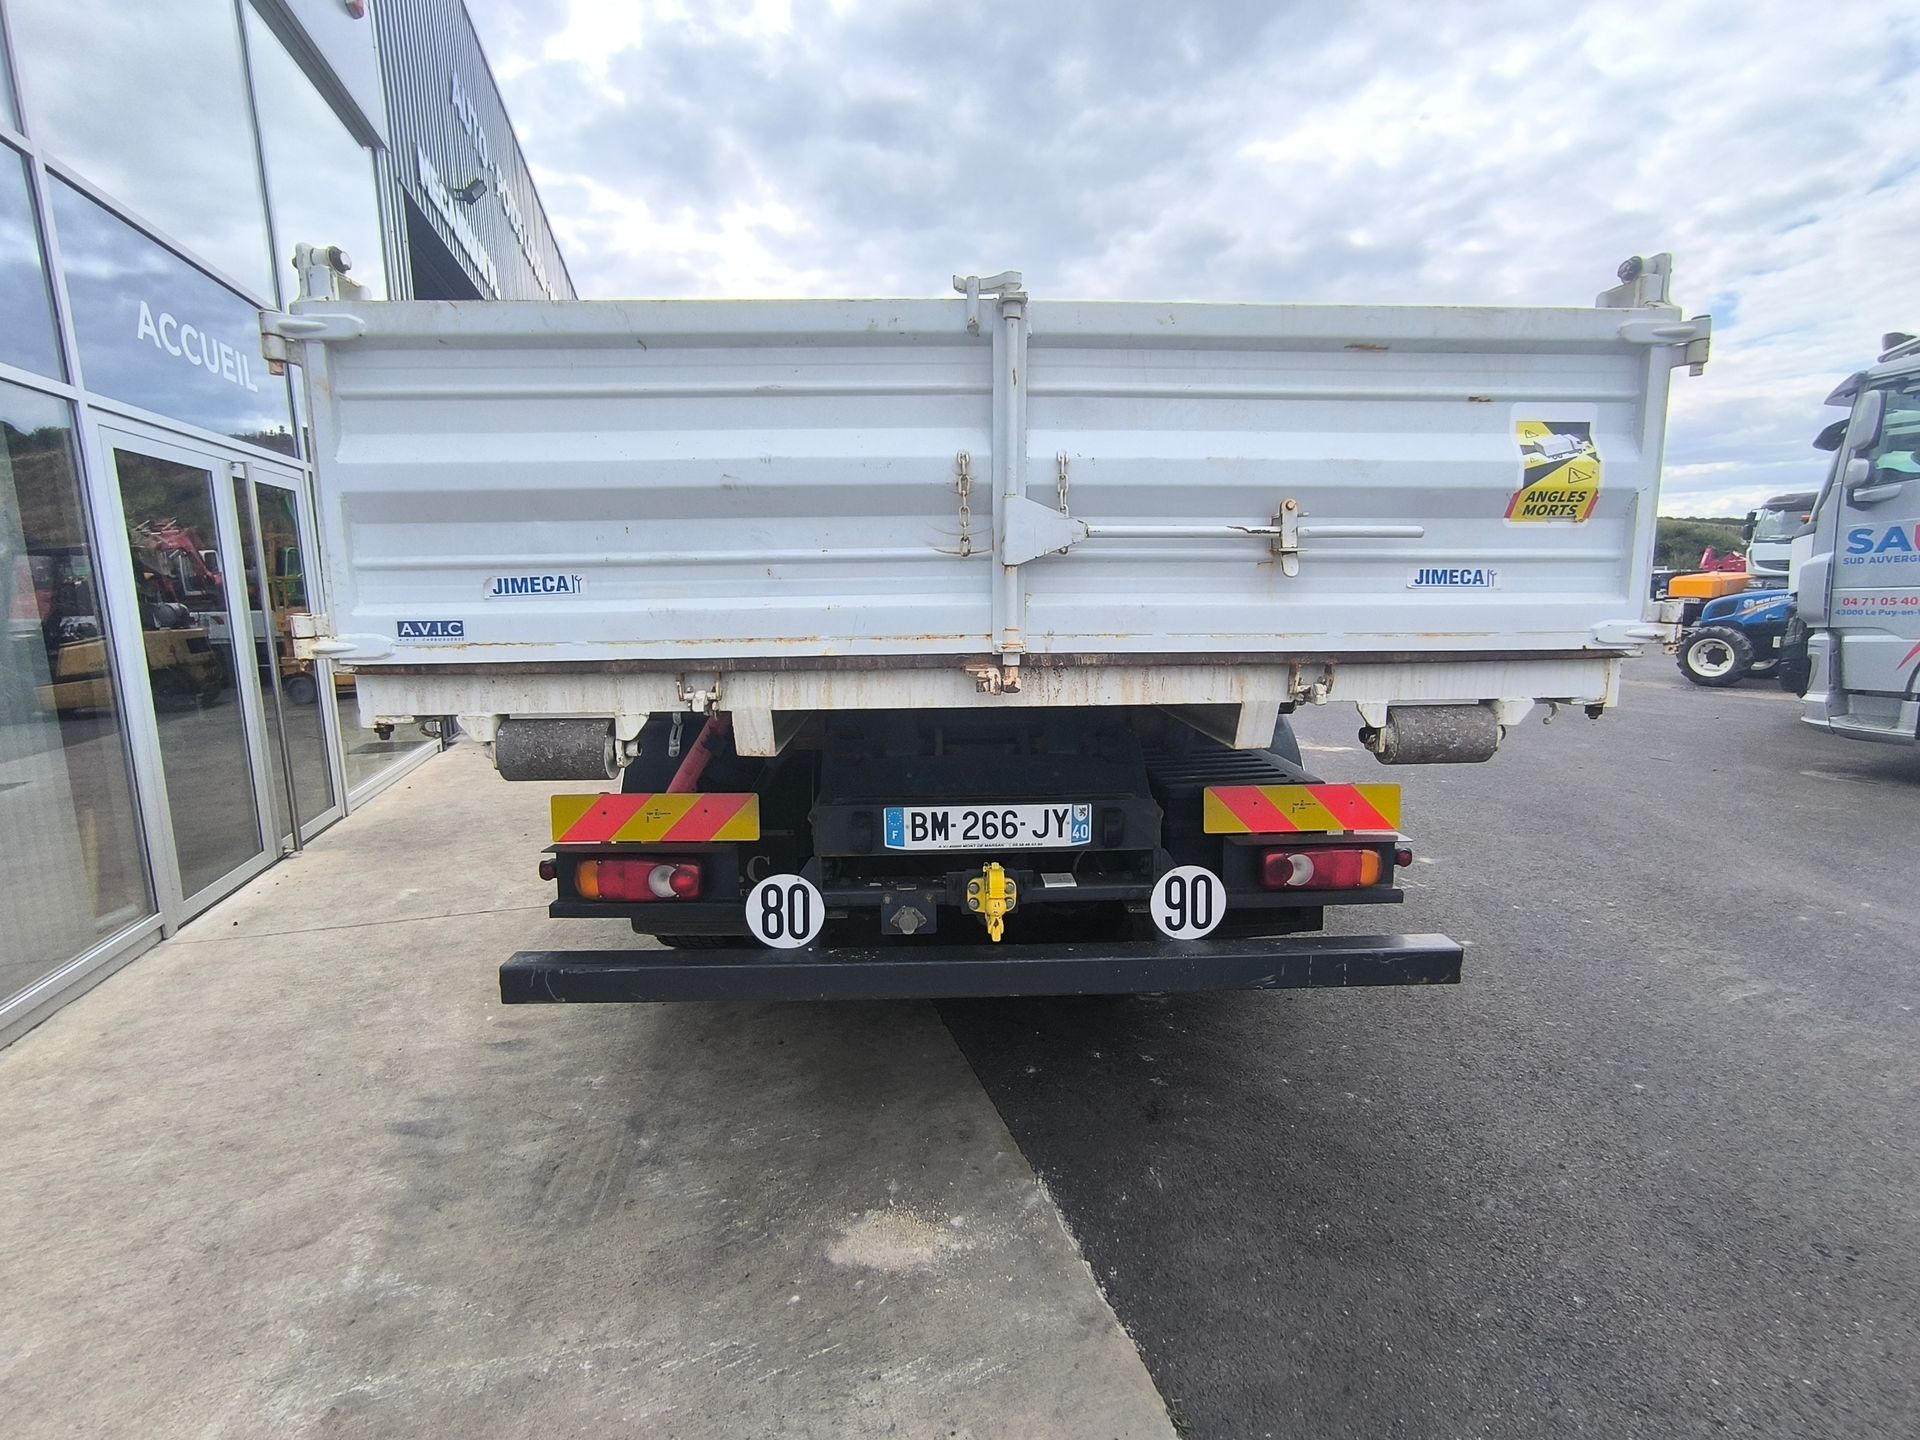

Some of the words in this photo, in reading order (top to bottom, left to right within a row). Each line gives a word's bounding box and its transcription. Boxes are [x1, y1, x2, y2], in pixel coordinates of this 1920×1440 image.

[137, 300, 258, 393] ACCUEIL
[1525, 491, 1587, 502] ANGLES
[1522, 504, 1578, 516] MORTS
[1843, 557, 1864, 565] SUD
[1869, 555, 1920, 564] AUVERG
[1414, 569, 1485, 585] JIMECA
[492, 575, 569, 594] JIMECA
[1843, 597, 1857, 606] 04
[1861, 597, 1876, 606] 71
[1880, 597, 1897, 606] 05
[1900, 596, 1918, 606] 40
[1878, 609, 1920, 617] Puy-en-
[892, 830, 898, 840] F
[1072, 824, 1088, 839] 40
[1165, 874, 1212, 931] 90
[761, 883, 810, 940] 80
